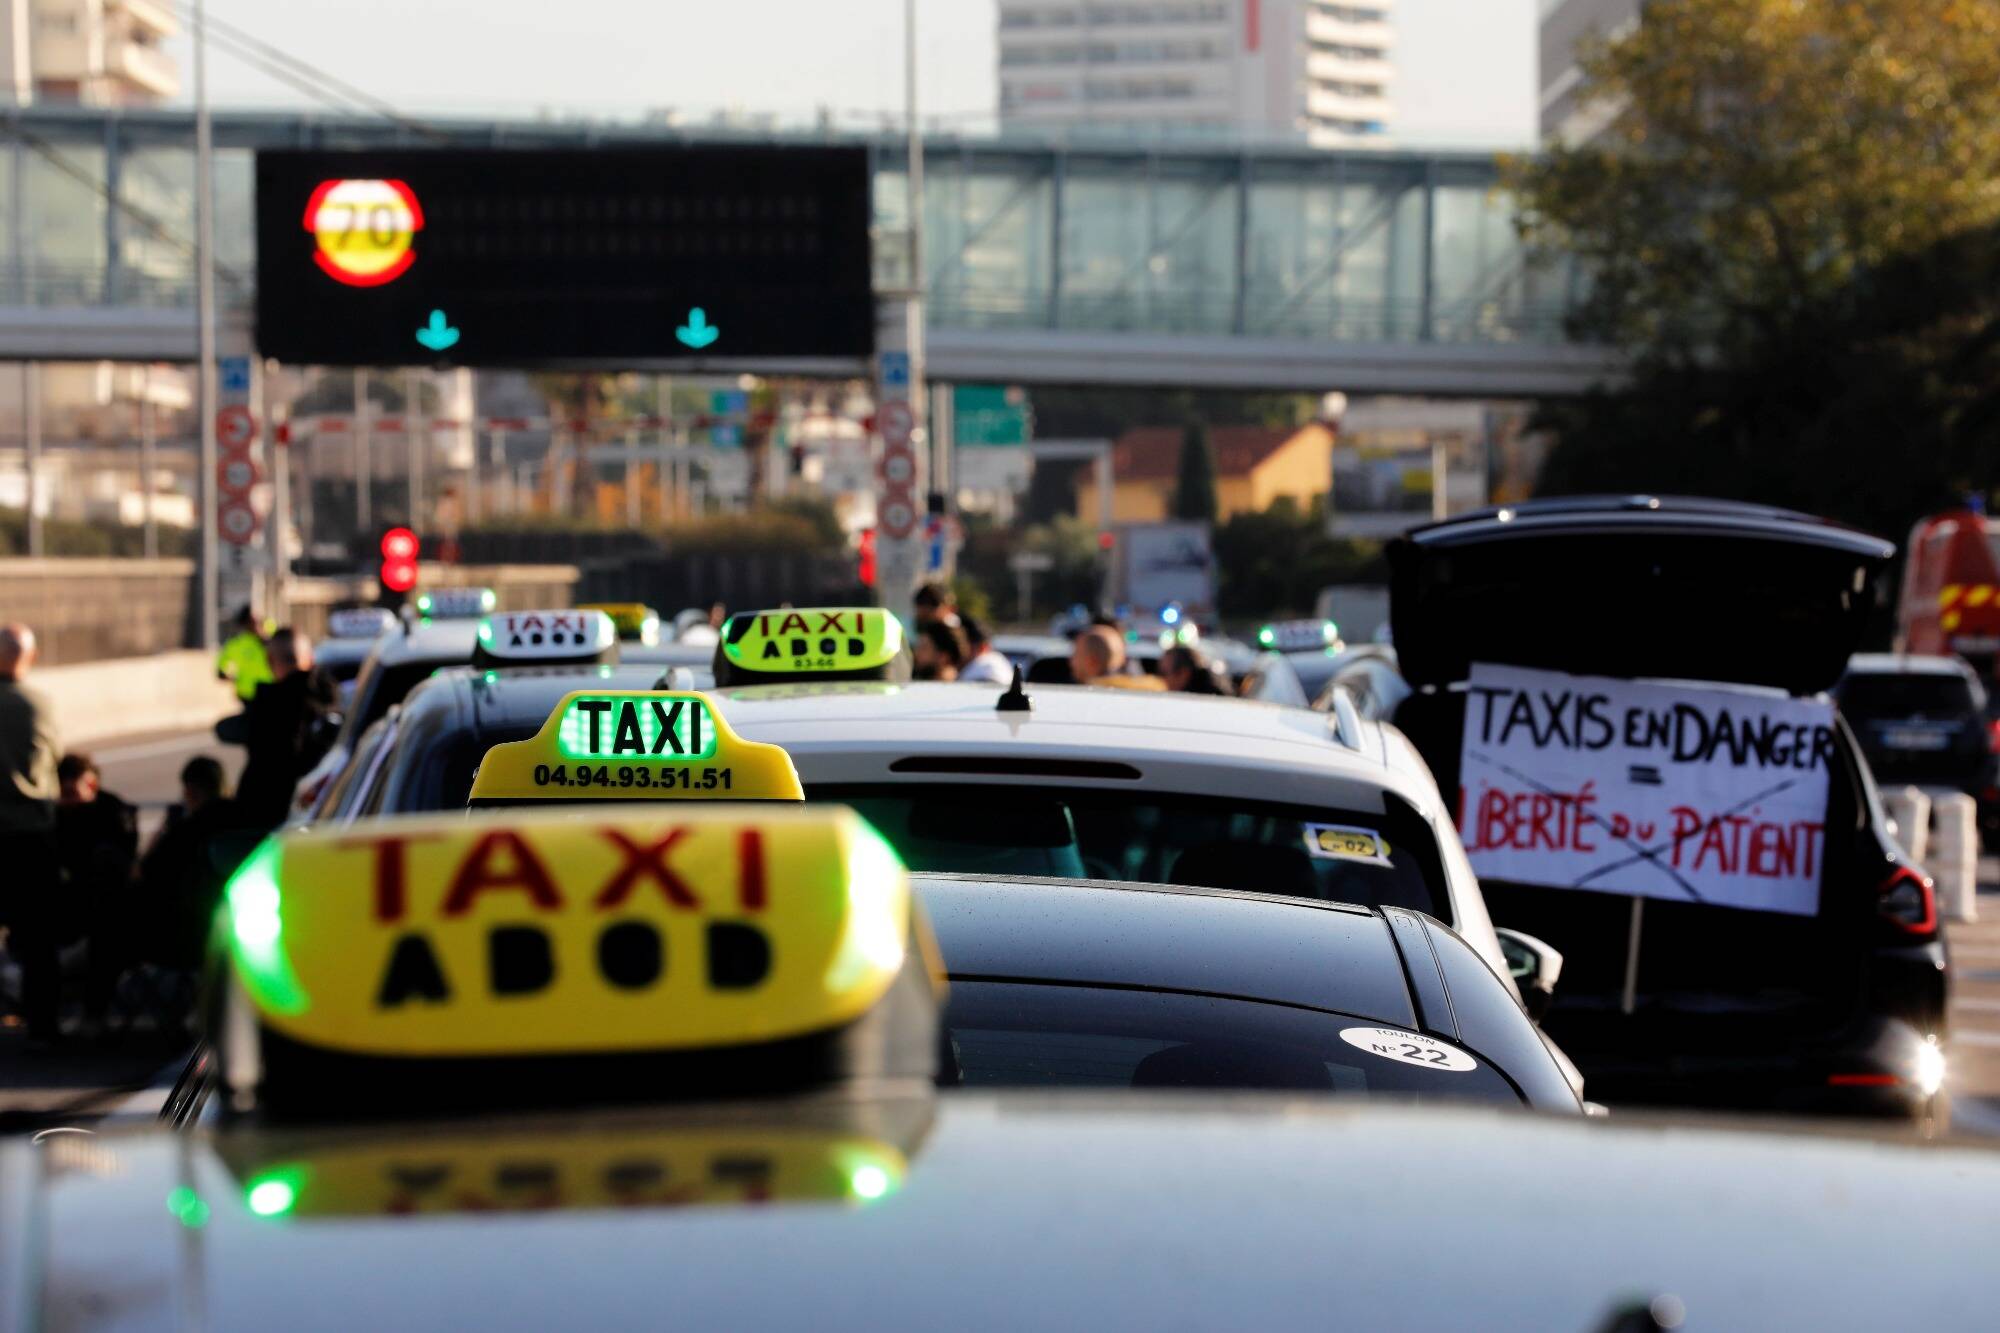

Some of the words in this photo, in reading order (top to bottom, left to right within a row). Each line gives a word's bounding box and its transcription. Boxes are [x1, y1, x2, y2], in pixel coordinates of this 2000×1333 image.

[336, 203, 397, 250] 70
[505, 614, 587, 632] TAXI
[758, 612, 865, 637] TAXI
[577, 701, 701, 754] TAXI
[1470, 685, 1615, 749] TAXIS
[1623, 708, 1670, 748] EN
[1672, 703, 1835, 770] DANGER
[534, 765, 731, 789] 04.94.93.51.51
[1670, 805, 1825, 879] PATIENT
[337, 826, 769, 923] TAXI
[1376, 1029, 1435, 1046] TOULON
[1400, 1043, 1451, 1067] 22
